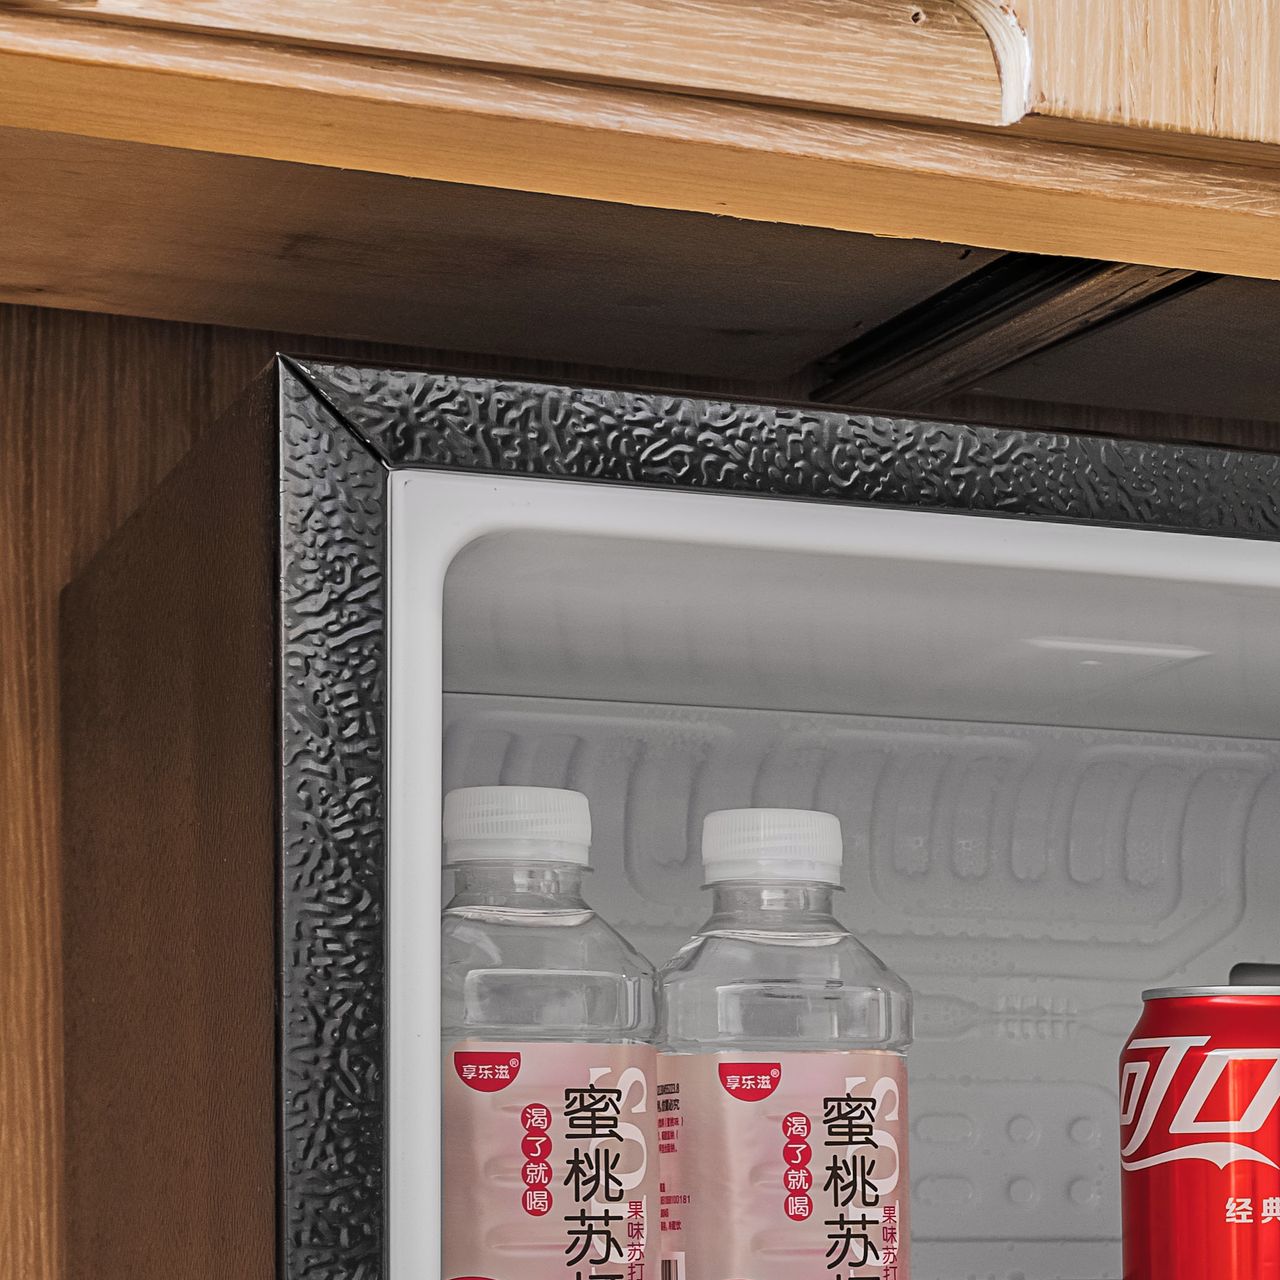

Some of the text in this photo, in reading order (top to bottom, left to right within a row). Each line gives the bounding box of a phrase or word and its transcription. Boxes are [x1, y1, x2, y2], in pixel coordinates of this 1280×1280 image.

[462, 1064, 511, 1080] 享乐滋
[725, 1074, 773, 1091] 享乐滋
[525, 1107, 549, 1212] 渴了就喝
[786, 1115, 810, 1218] 渴了就喝
